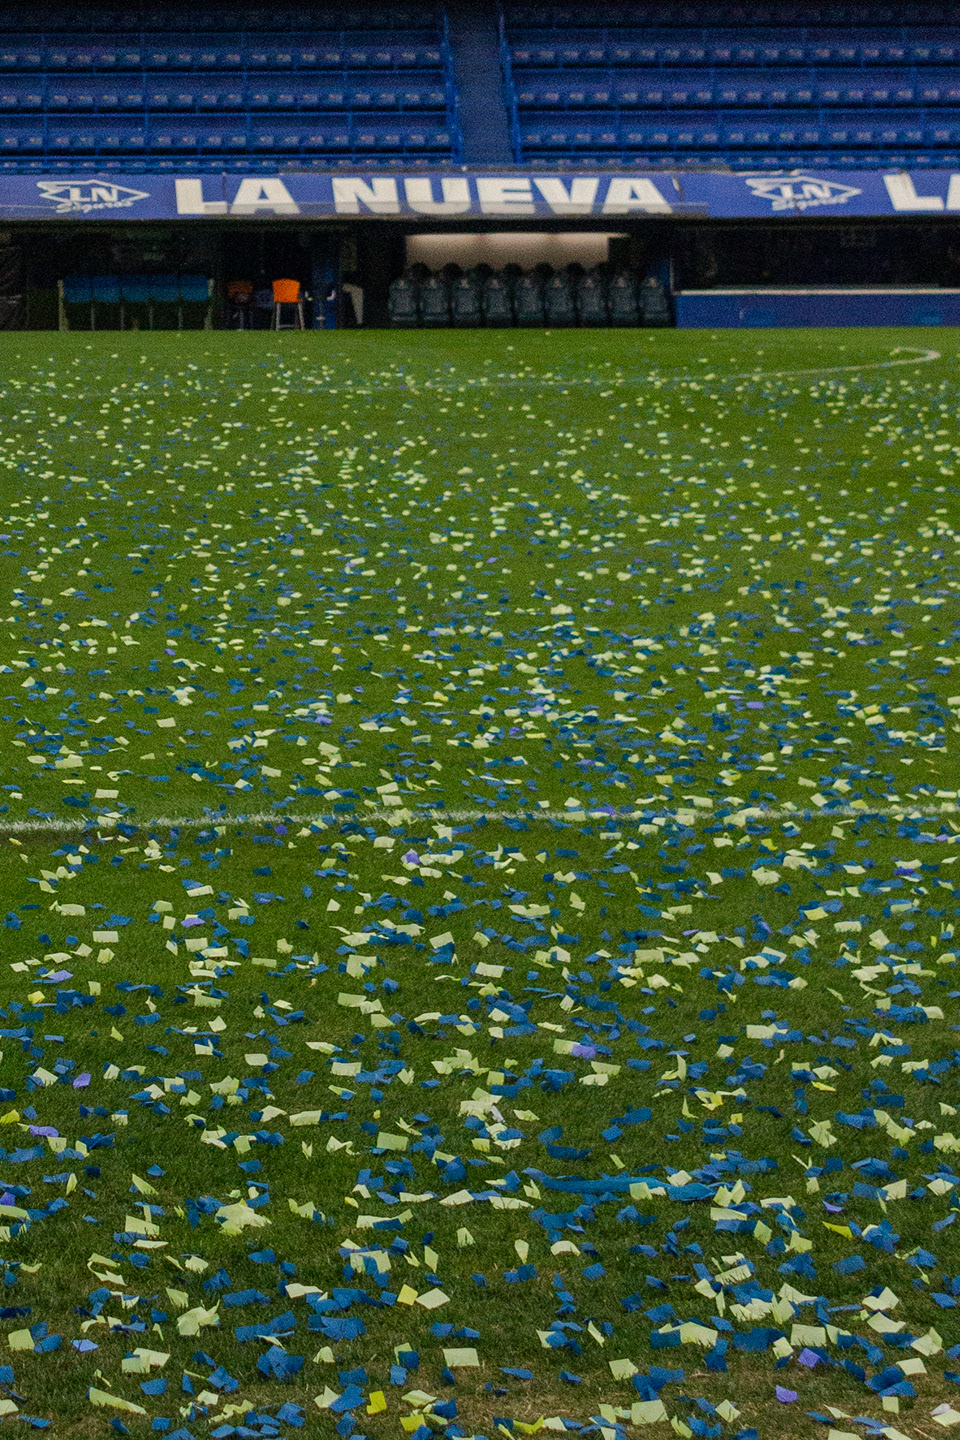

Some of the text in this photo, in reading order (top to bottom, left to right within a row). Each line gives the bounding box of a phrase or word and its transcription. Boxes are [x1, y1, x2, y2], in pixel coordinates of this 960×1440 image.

[69, 188, 118, 202] LN
[175, 177, 674, 214] LA NUEVA
[780, 184, 832, 199] LN
[883, 173, 960, 211] L
